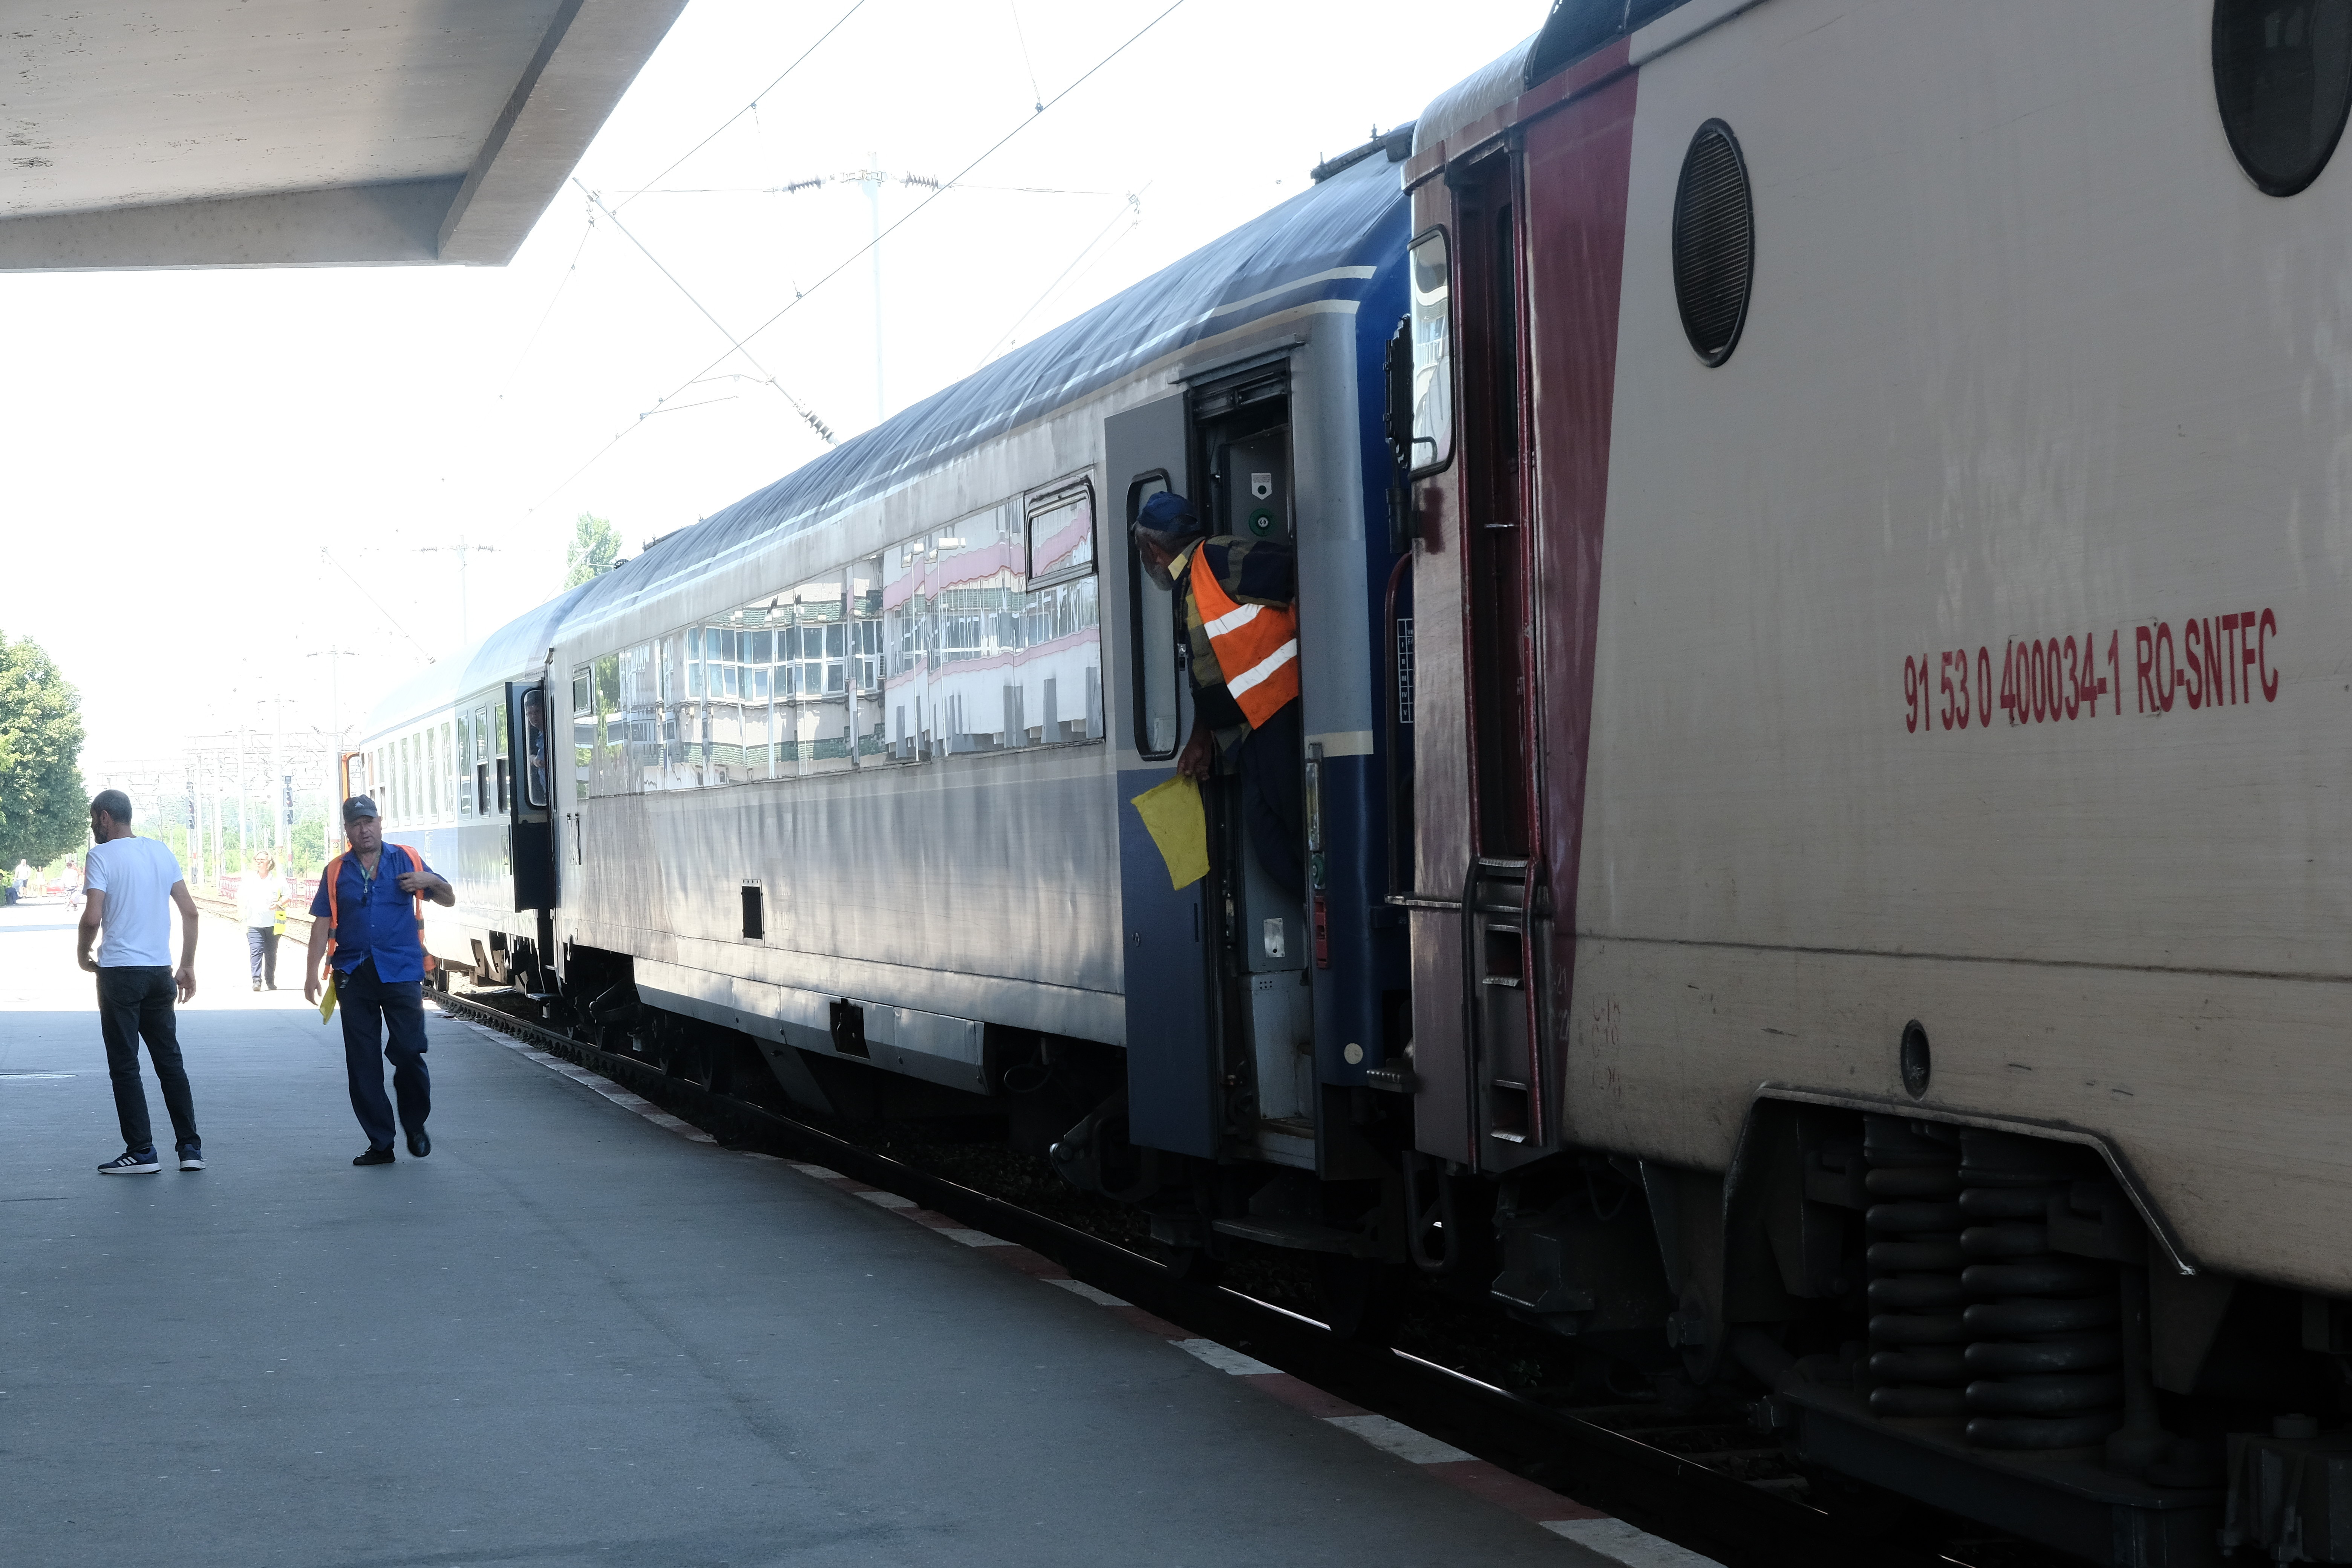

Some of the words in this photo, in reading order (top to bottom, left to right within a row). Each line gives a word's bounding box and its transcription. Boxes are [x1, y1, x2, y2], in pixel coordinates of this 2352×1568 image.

[1904, 653, 1930, 733] 91
[1940, 649, 1969, 730] 53
[1977, 646, 1992, 728] 0
[2000, 629, 2121, 725] 400034-1
[2136, 608, 2278, 714] RO-SNTFC
